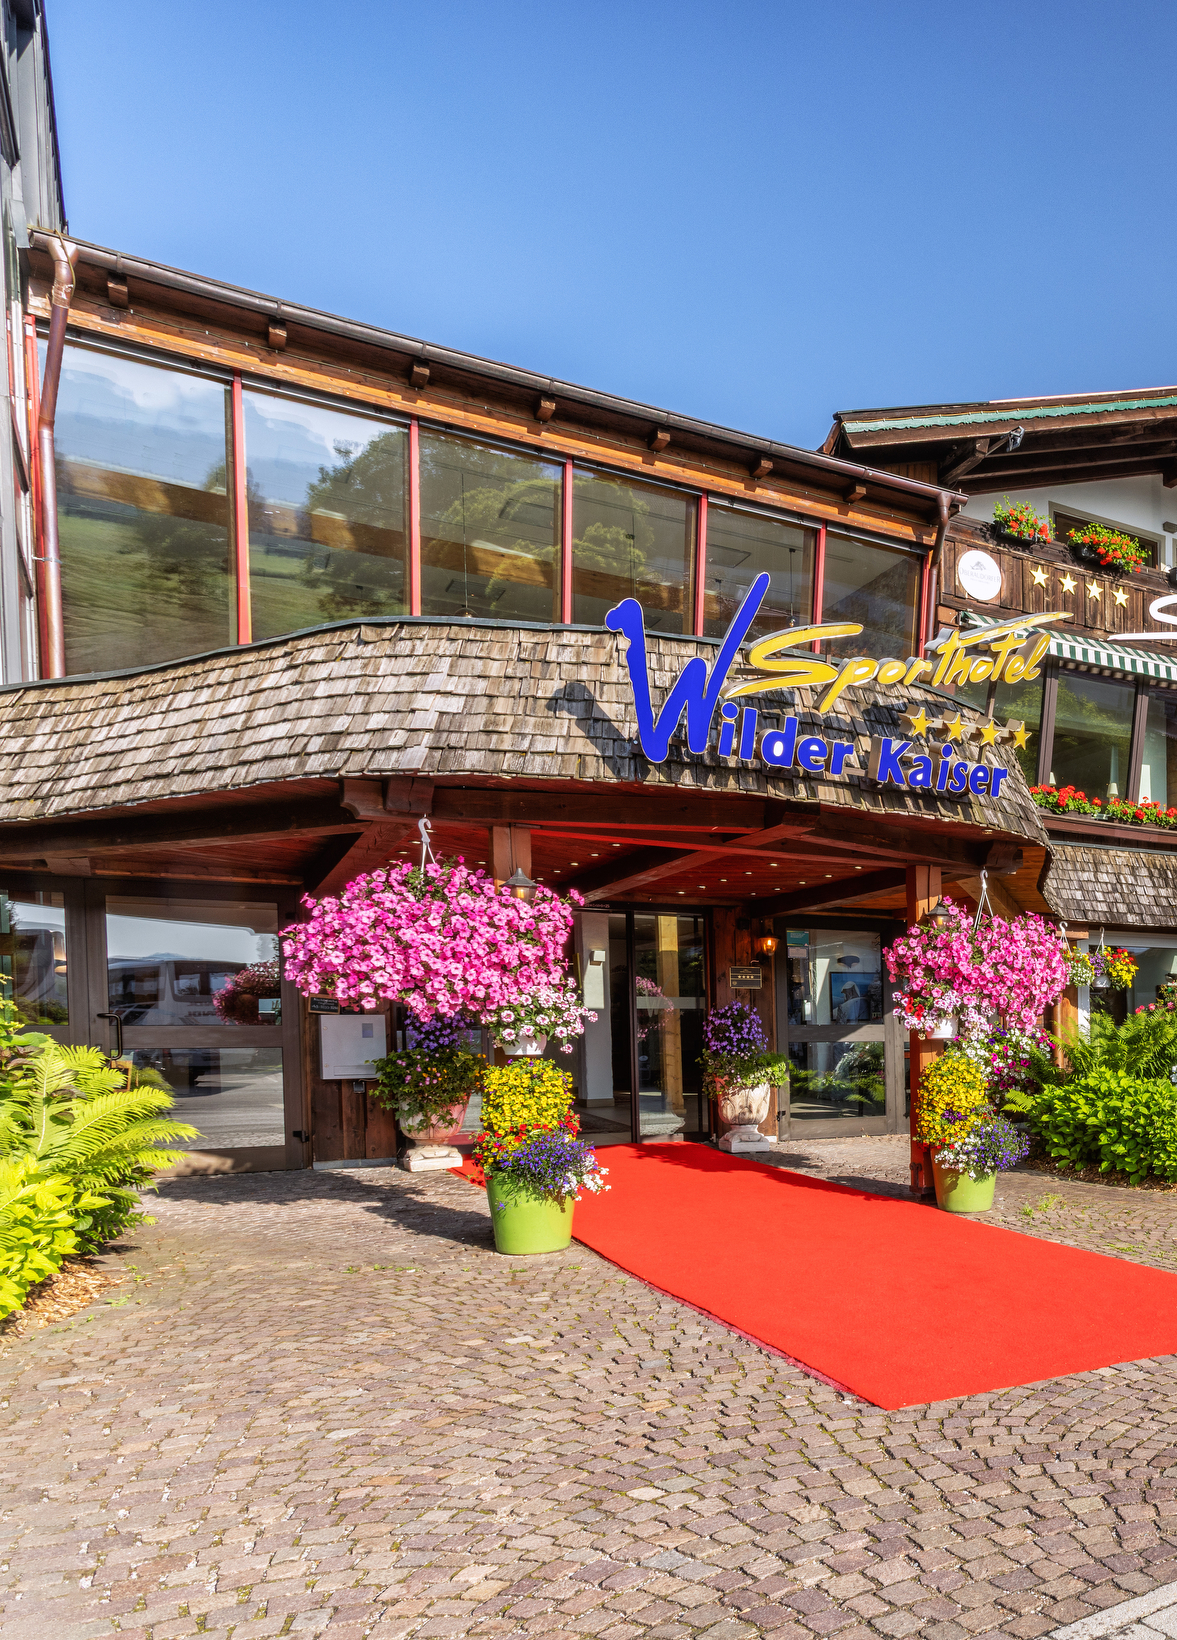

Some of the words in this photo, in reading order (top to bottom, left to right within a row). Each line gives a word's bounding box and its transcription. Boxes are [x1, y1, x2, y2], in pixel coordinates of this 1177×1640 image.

[605, 572, 855, 776] Wilder
[875, 736, 1008, 799] Kaiser
[721, 611, 1074, 713] Sporthotel
